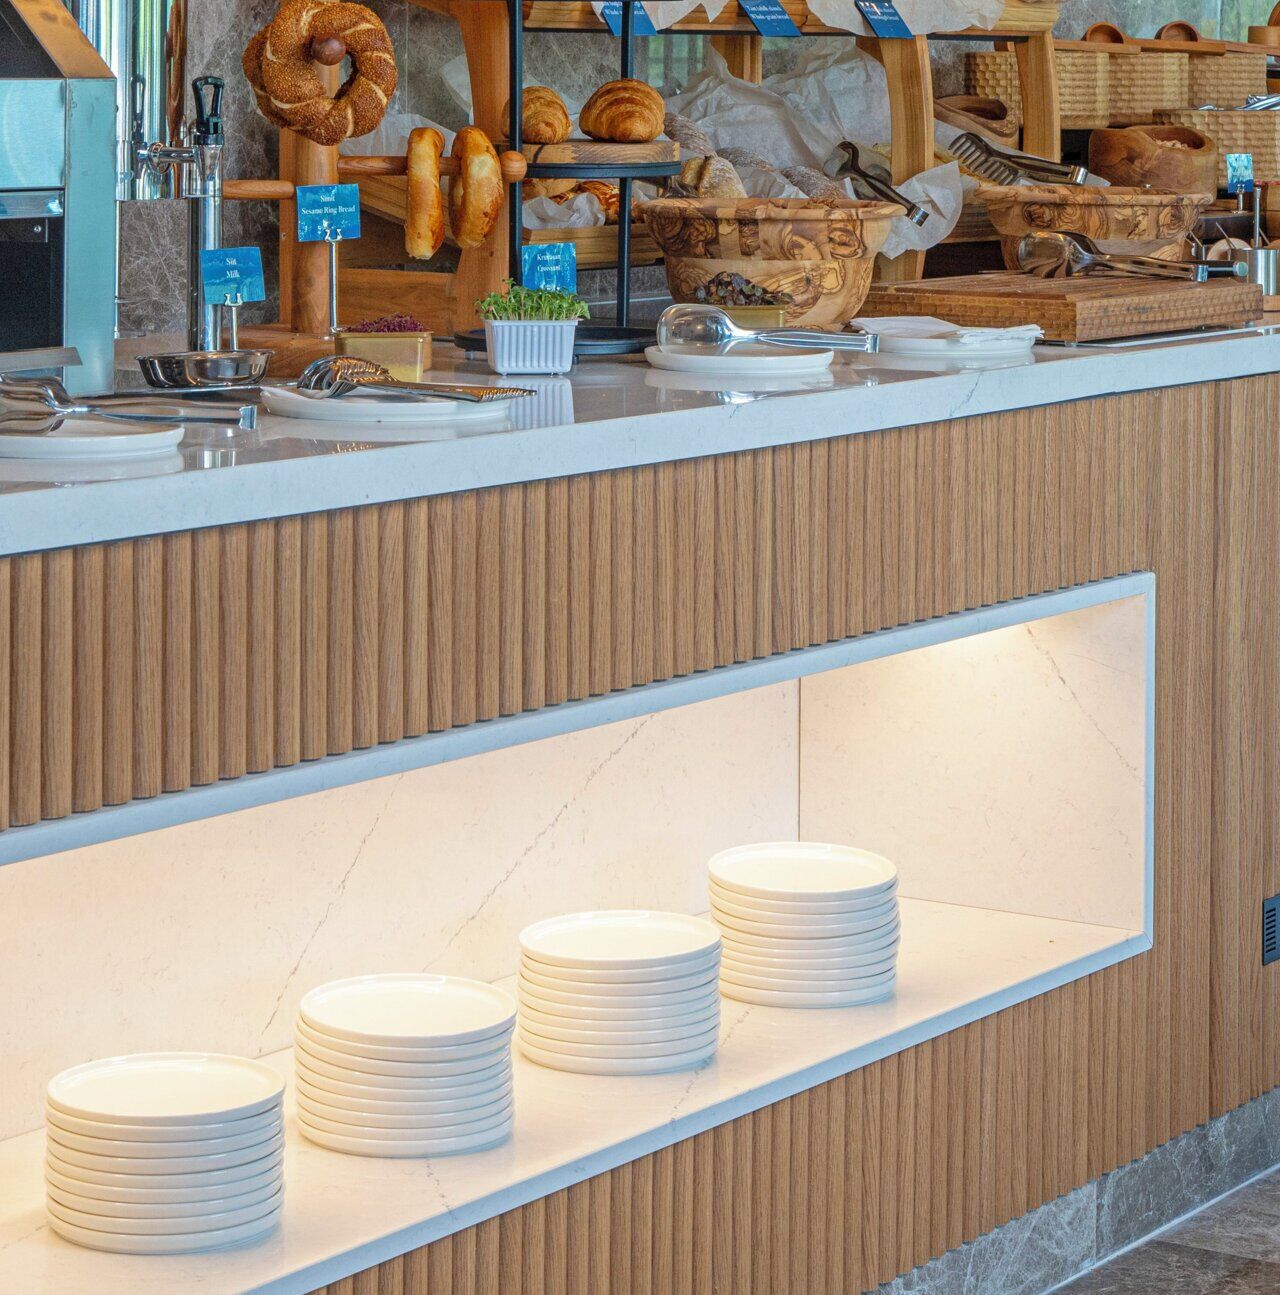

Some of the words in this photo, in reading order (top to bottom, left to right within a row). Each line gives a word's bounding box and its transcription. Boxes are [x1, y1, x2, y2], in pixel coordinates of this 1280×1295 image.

[323, 206, 337, 215] Ring
[338, 205, 355, 213] Bread
[226, 269, 240, 279] Milk
